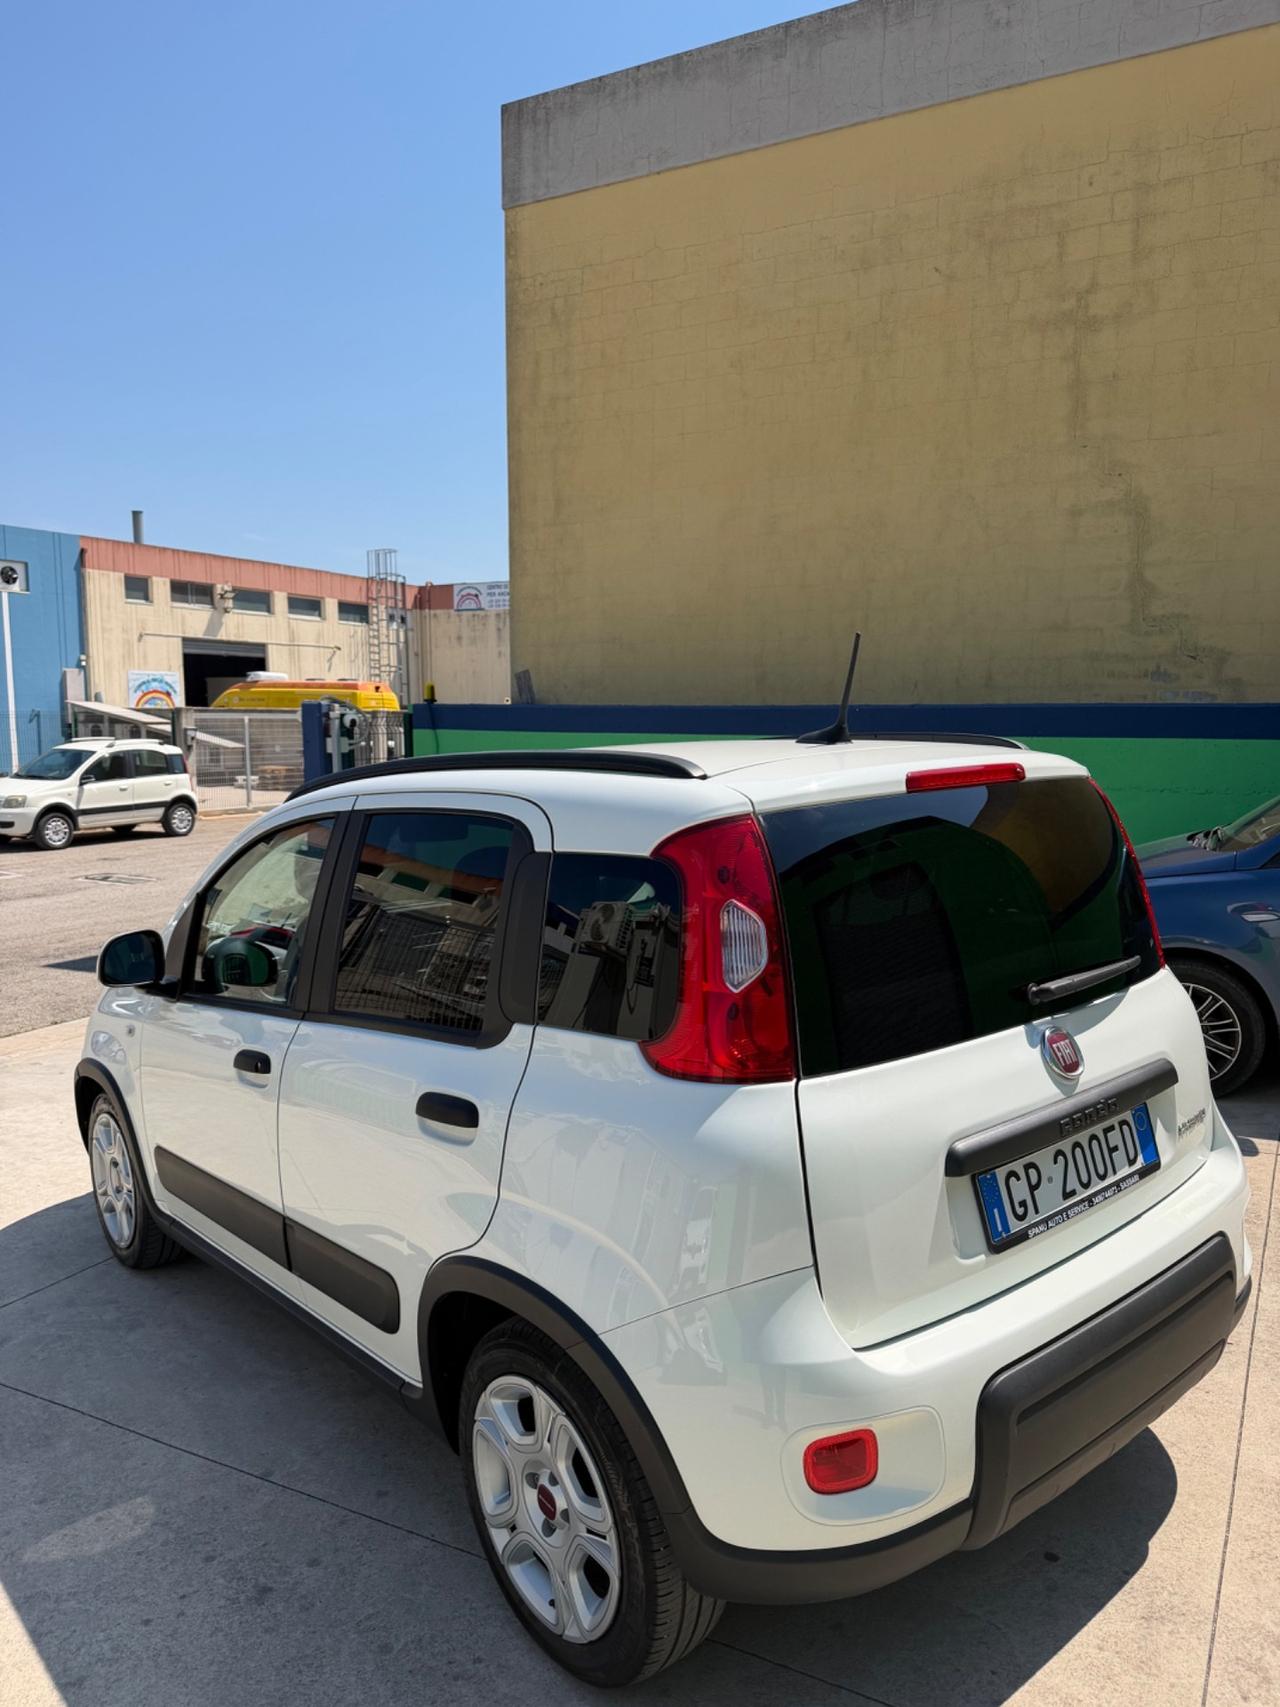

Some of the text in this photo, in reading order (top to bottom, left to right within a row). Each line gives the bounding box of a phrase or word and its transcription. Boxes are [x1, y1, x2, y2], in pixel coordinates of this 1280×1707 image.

[1052, 1039, 1078, 1066] FIAT
[1028, 1222, 1048, 1239] SPANU
[1048, 1214, 1063, 1229] AUTO
[1062, 1213, 1068, 1222] E
[1067, 1201, 1090, 1220] SERVICE
[1119, 1174, 1140, 1192] SASSARI
